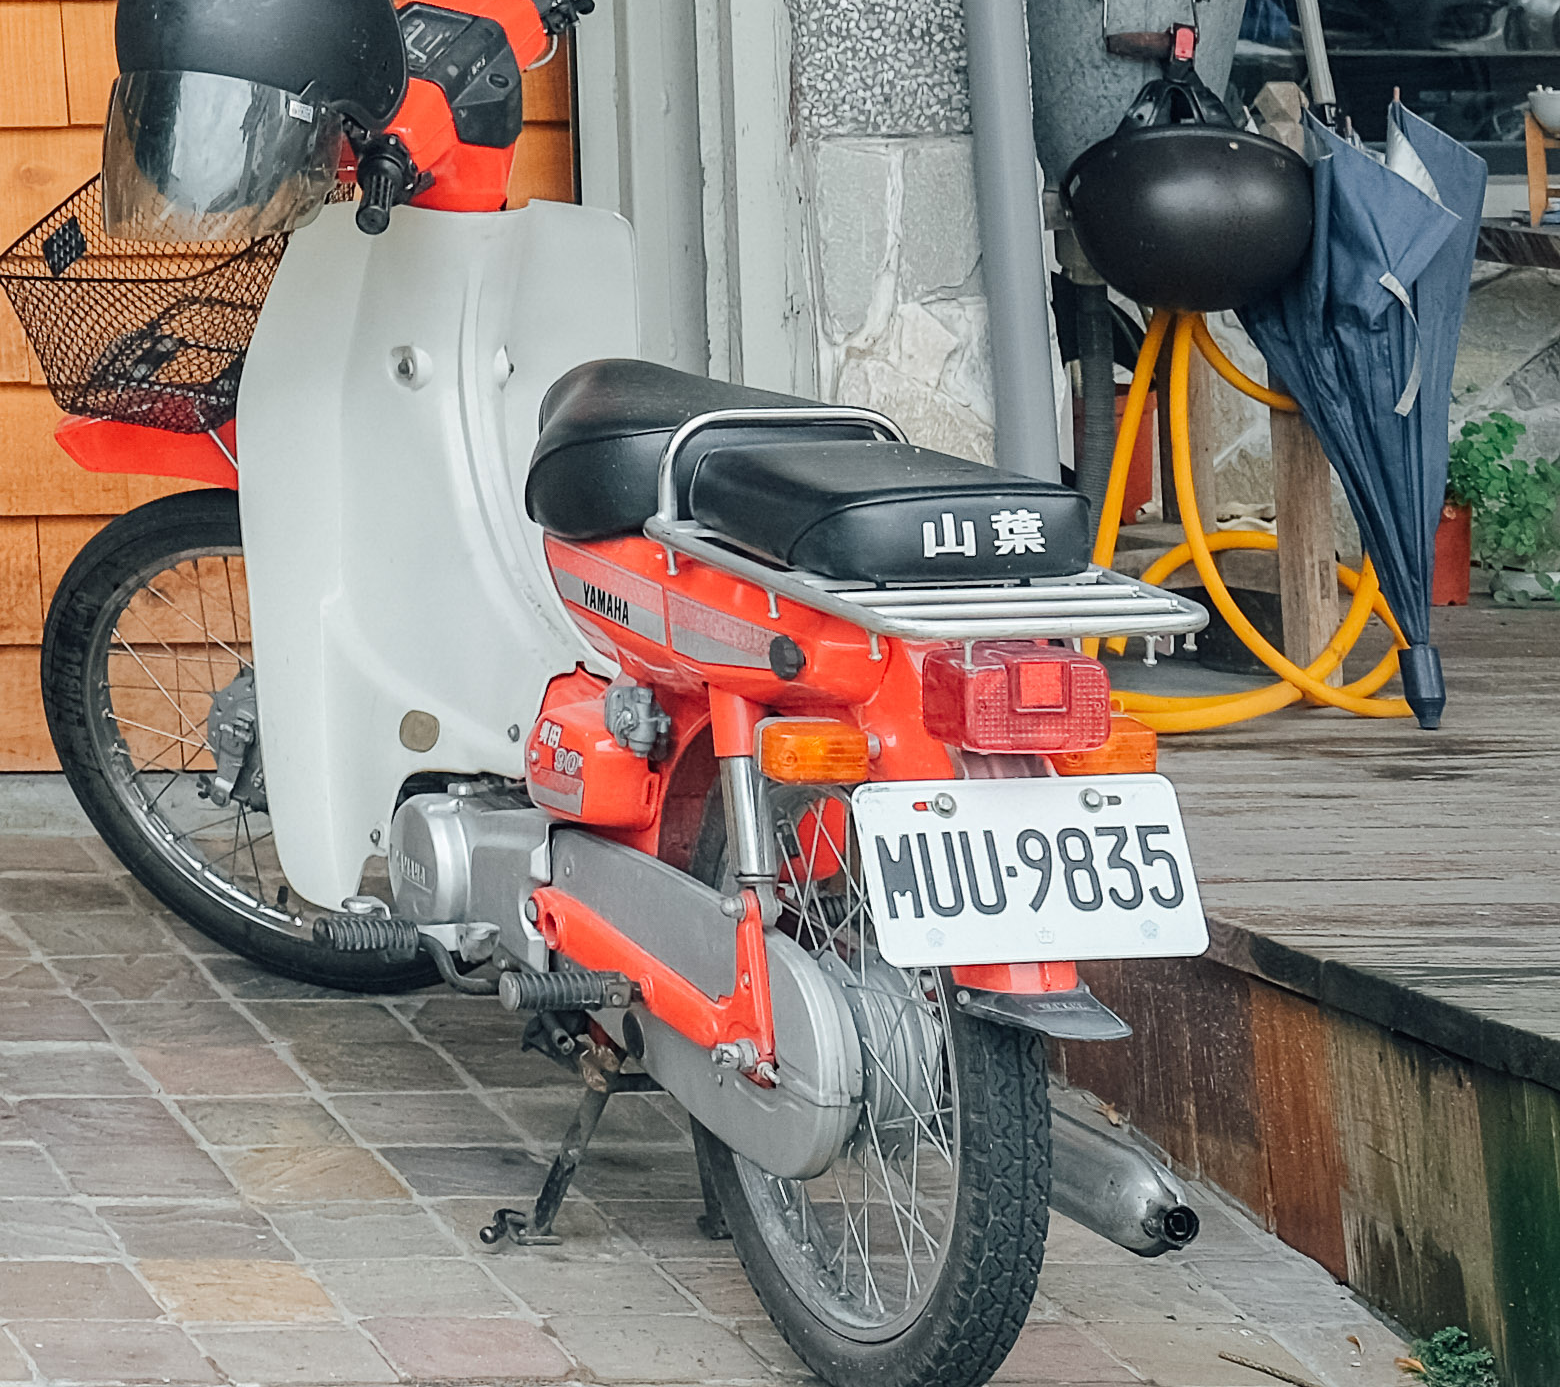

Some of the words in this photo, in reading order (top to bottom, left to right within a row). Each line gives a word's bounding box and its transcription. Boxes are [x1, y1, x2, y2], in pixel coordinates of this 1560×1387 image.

[922, 508, 1047, 558] 山葉
[583, 581, 629, 626] YAMAHA
[875, 825, 1185, 920] MUU-9835
